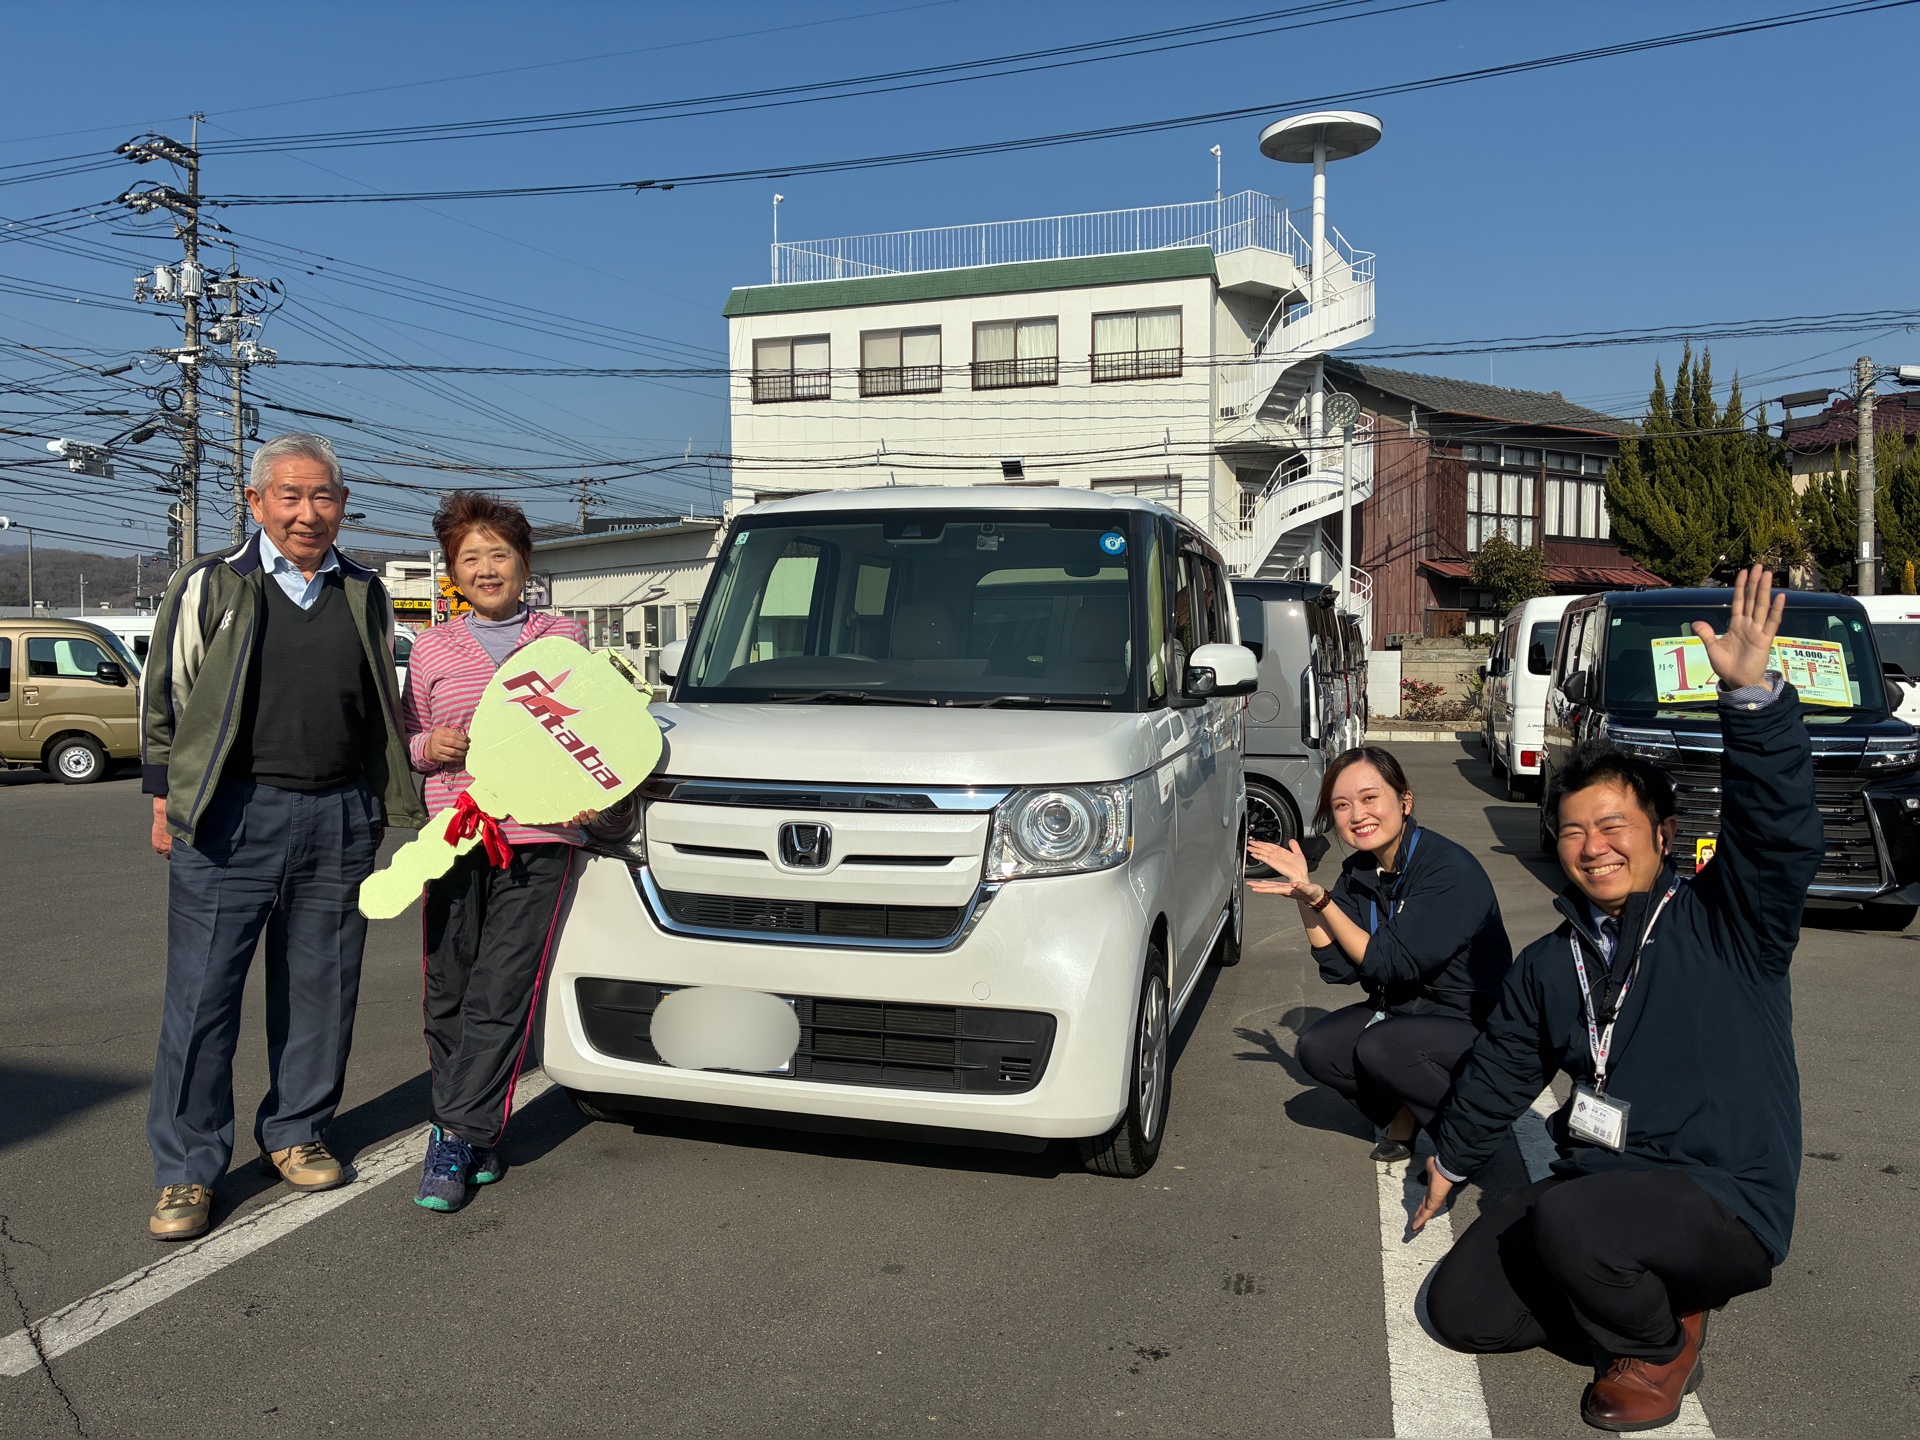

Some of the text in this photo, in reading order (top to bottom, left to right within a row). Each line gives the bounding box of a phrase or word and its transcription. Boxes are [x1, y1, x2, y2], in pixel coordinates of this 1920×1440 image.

[1109, 540, 1116, 548] 9
[1658, 663, 1675, 671] 月々
[502, 670, 622, 790] Futaba
